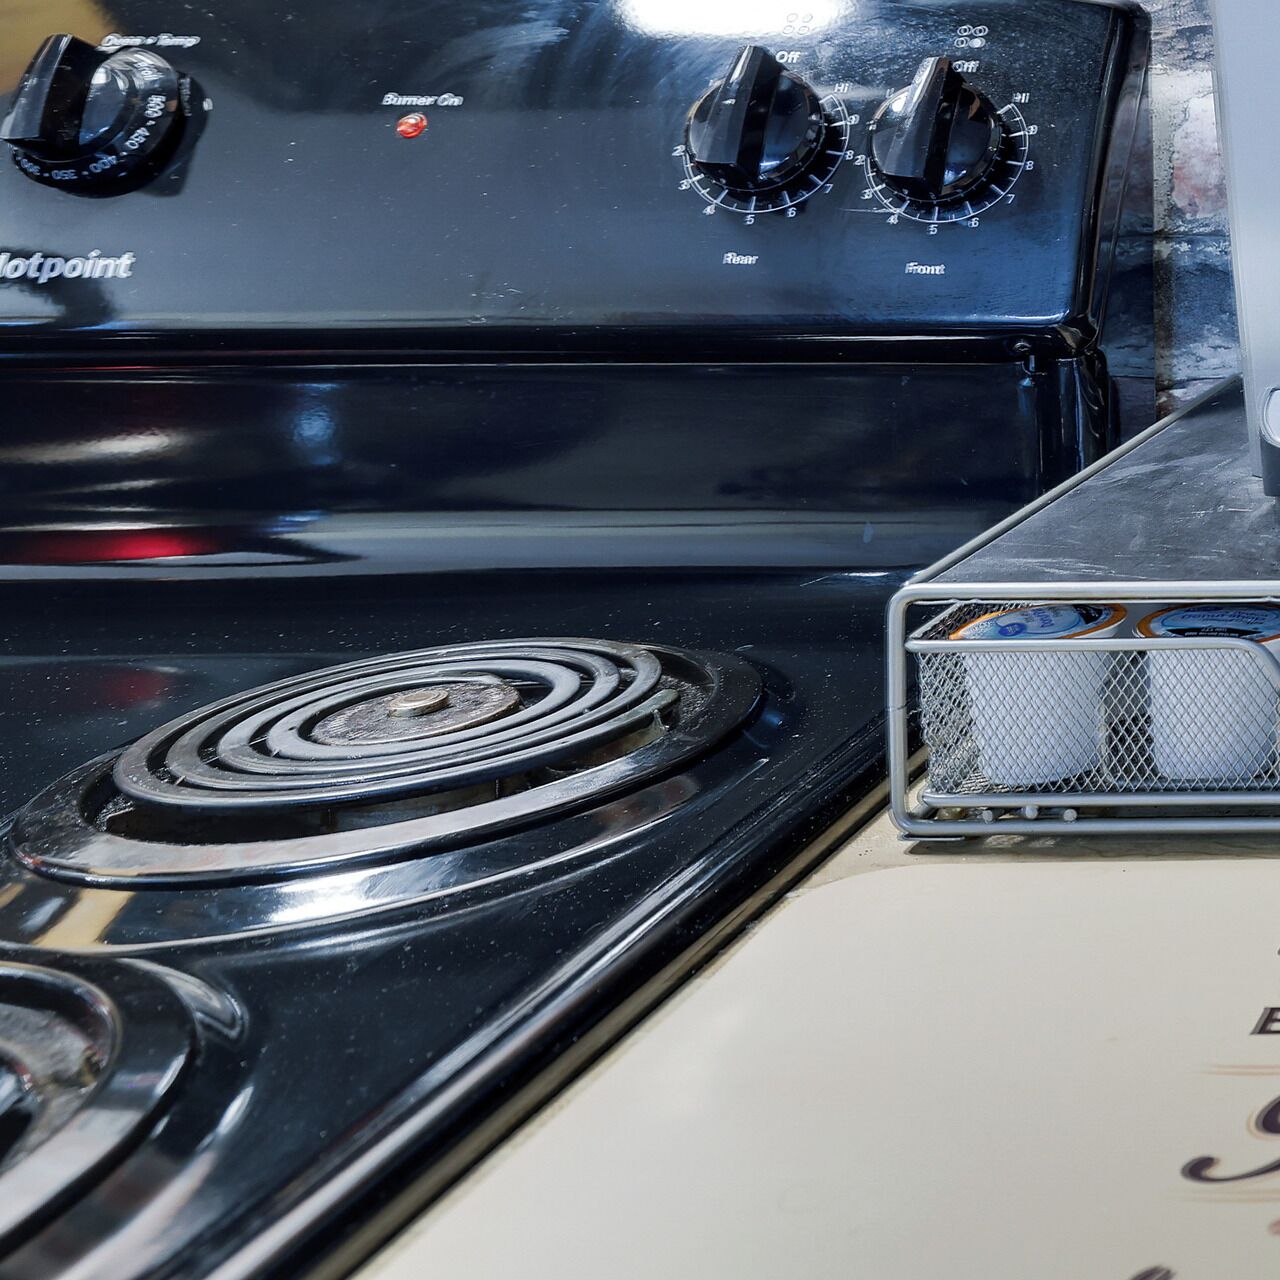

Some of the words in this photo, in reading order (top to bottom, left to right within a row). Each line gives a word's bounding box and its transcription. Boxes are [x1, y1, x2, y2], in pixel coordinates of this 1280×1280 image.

[775, 51, 800, 63] Off
[834, 83, 849, 93] Hi
[381, 93, 435, 107] Burner
[437, 93, 463, 107] On
[145, 95, 166, 118] 500
[124, 127, 150, 149] 450
[845, 151, 854, 160] 8
[89, 155, 118, 173] 400
[1025, 161, 1034, 170] 8
[51, 170, 78, 180] 350
[823, 184, 833, 193] 7
[1007, 194, 1015, 204] 7
[787, 207, 797, 217] 6
[745, 215, 755, 225] 5
[723, 253, 759, 265] Rear
[905, 262, 945, 275] Front
